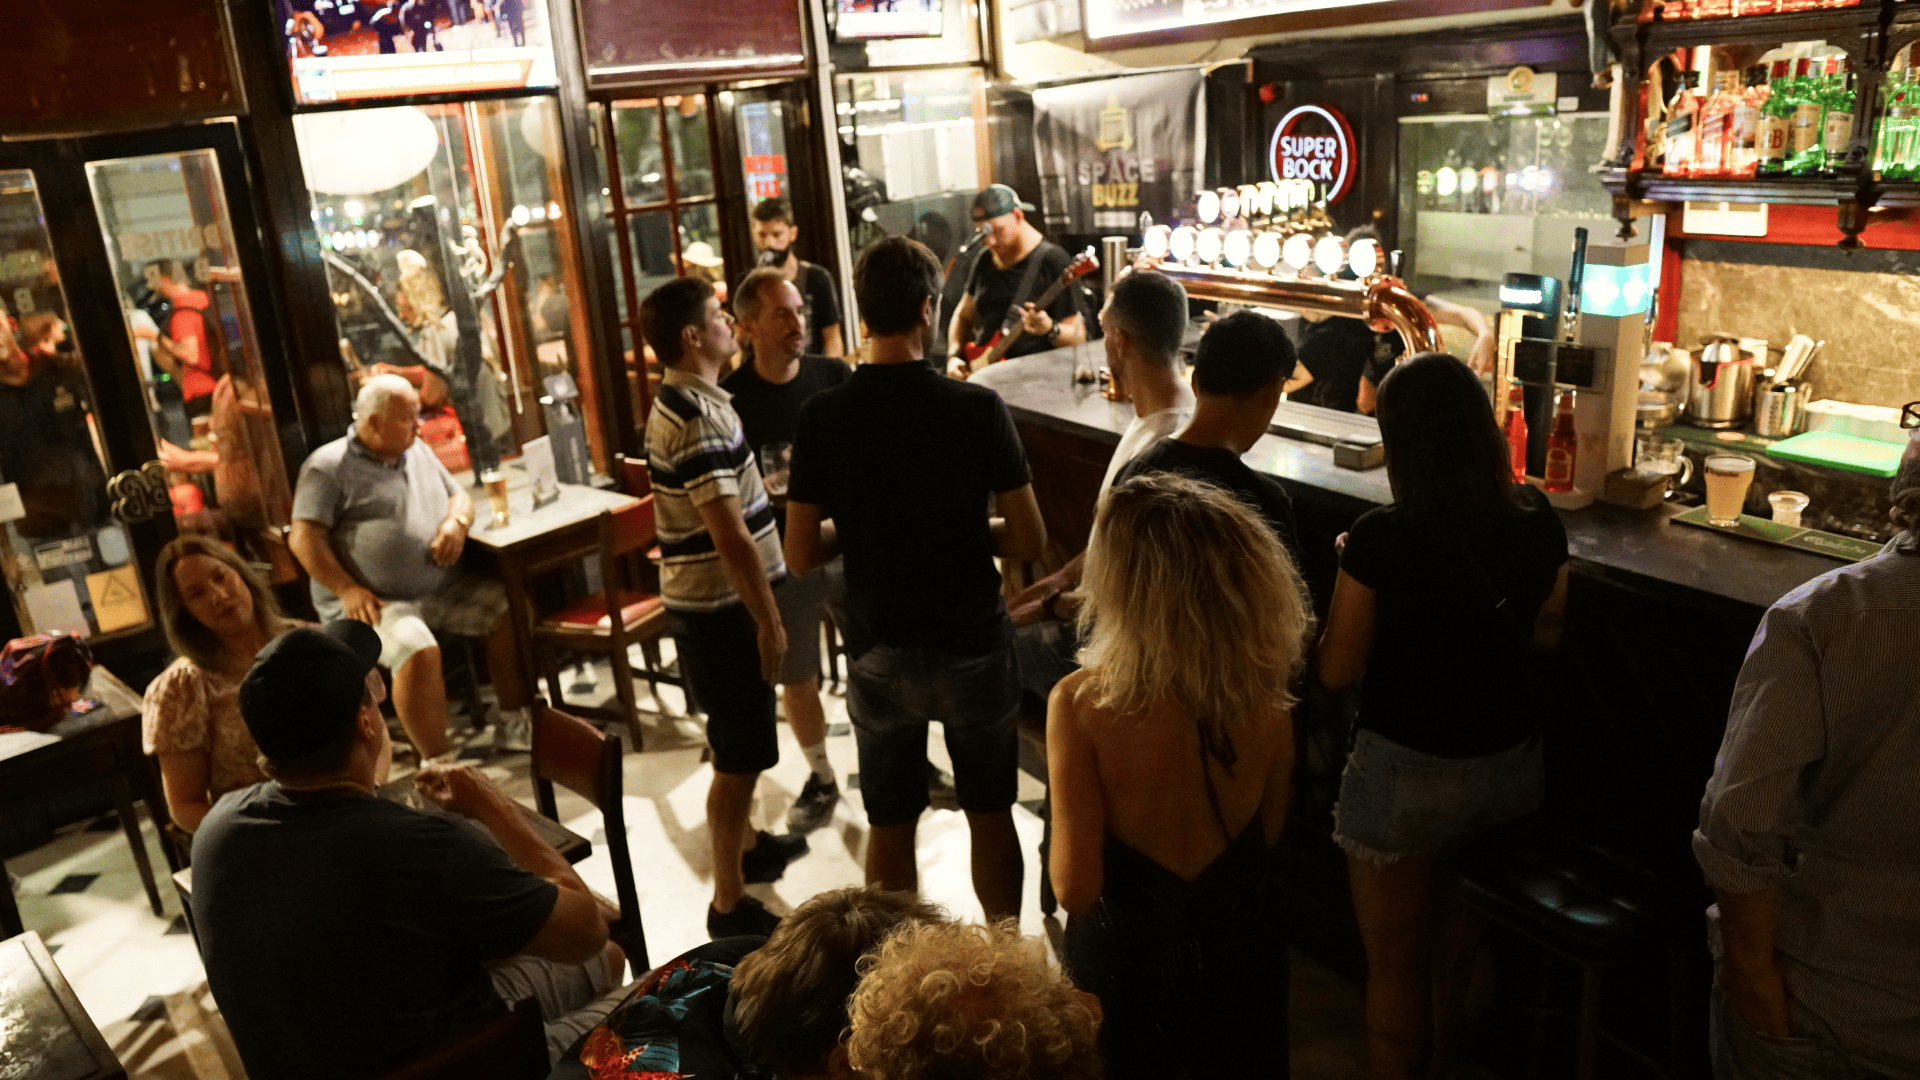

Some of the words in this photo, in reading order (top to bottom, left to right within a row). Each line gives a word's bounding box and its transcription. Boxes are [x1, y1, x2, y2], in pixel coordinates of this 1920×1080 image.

[1280, 135, 1337, 159] SUPER
[1078, 154, 1156, 184] SPACE
[1283, 157, 1333, 181] BOCK
[1092, 182, 1140, 208] BUZZ
